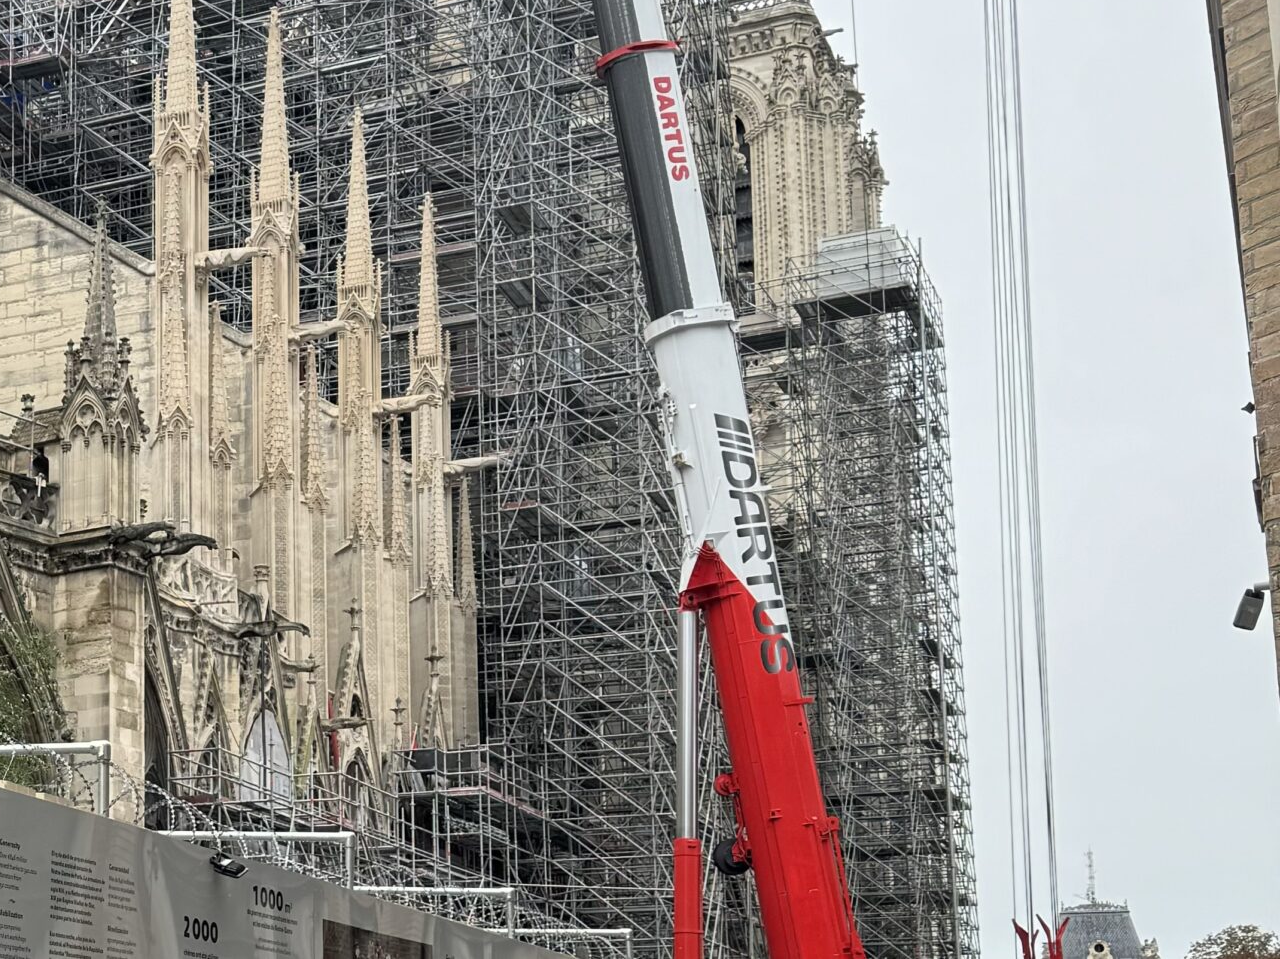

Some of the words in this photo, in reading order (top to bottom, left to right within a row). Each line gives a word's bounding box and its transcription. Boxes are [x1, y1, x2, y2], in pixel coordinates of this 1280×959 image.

[653, 76, 690, 181] DARTUS
[721, 450, 795, 674] DARTUS
[183, 915, 218, 943] 2000
[253, 886, 283, 911] 1000
